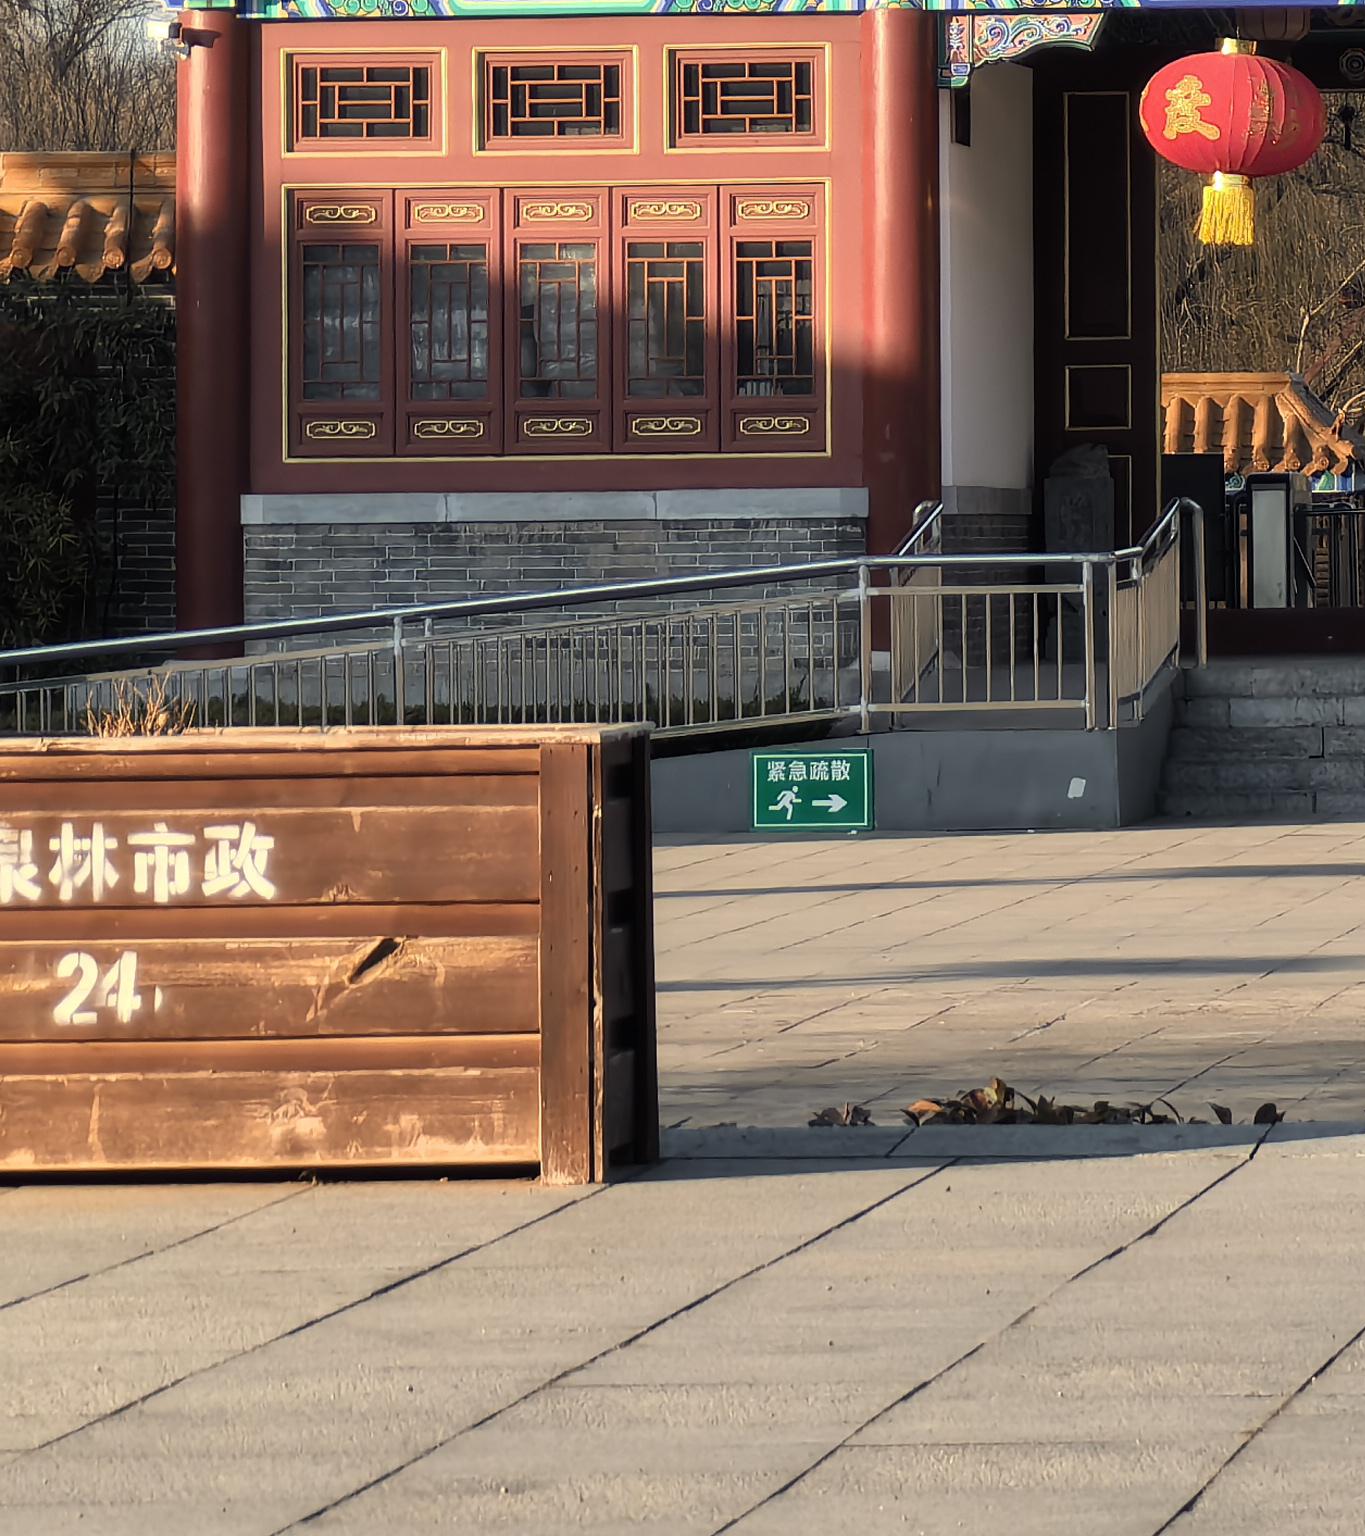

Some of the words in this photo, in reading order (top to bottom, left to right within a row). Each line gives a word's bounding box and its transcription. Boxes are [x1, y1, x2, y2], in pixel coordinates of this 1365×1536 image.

[766, 759, 851, 783] 紧急疏散
[53, 950, 142, 1025] 24
